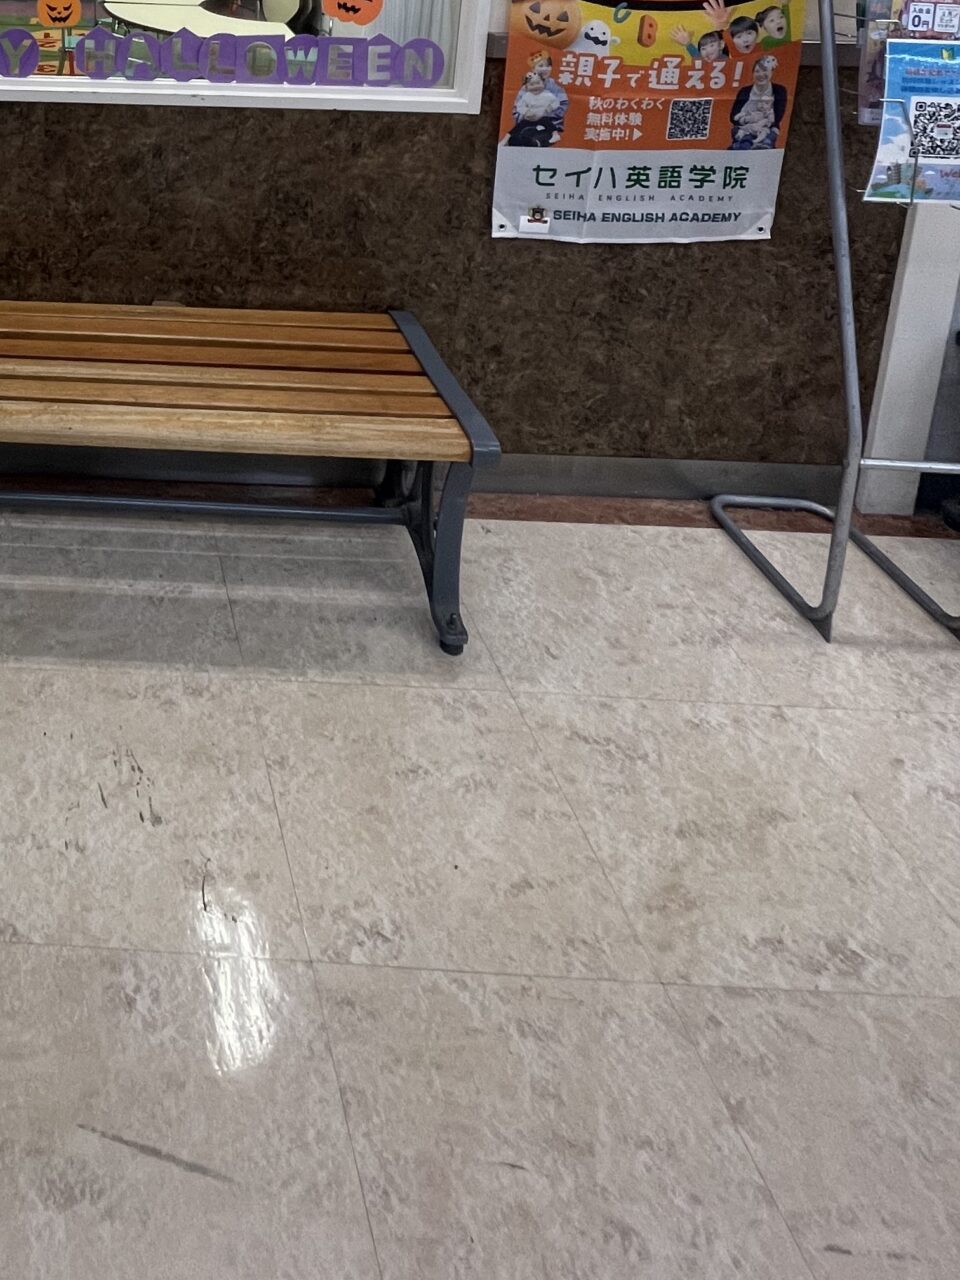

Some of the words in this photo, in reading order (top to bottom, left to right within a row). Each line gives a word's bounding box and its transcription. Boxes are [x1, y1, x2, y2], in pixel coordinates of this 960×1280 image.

[83, 36, 435, 83] HALLOWEEN
[558, 54, 744, 90] 親子で通える!
[588, 96, 666, 112] 秋のわくわく
[586, 111, 643, 127] 無料体験
[583, 127, 630, 143] 実施中!
[531, 164, 750, 190] セイハ英語学院
[545, 192, 585, 201] SEIHA
[598, 194, 655, 202] ENGLISH
[552, 209, 597, 223] SEIHA
[600, 211, 665, 224] ENGLISH
[668, 211, 742, 224] ACADEMY
